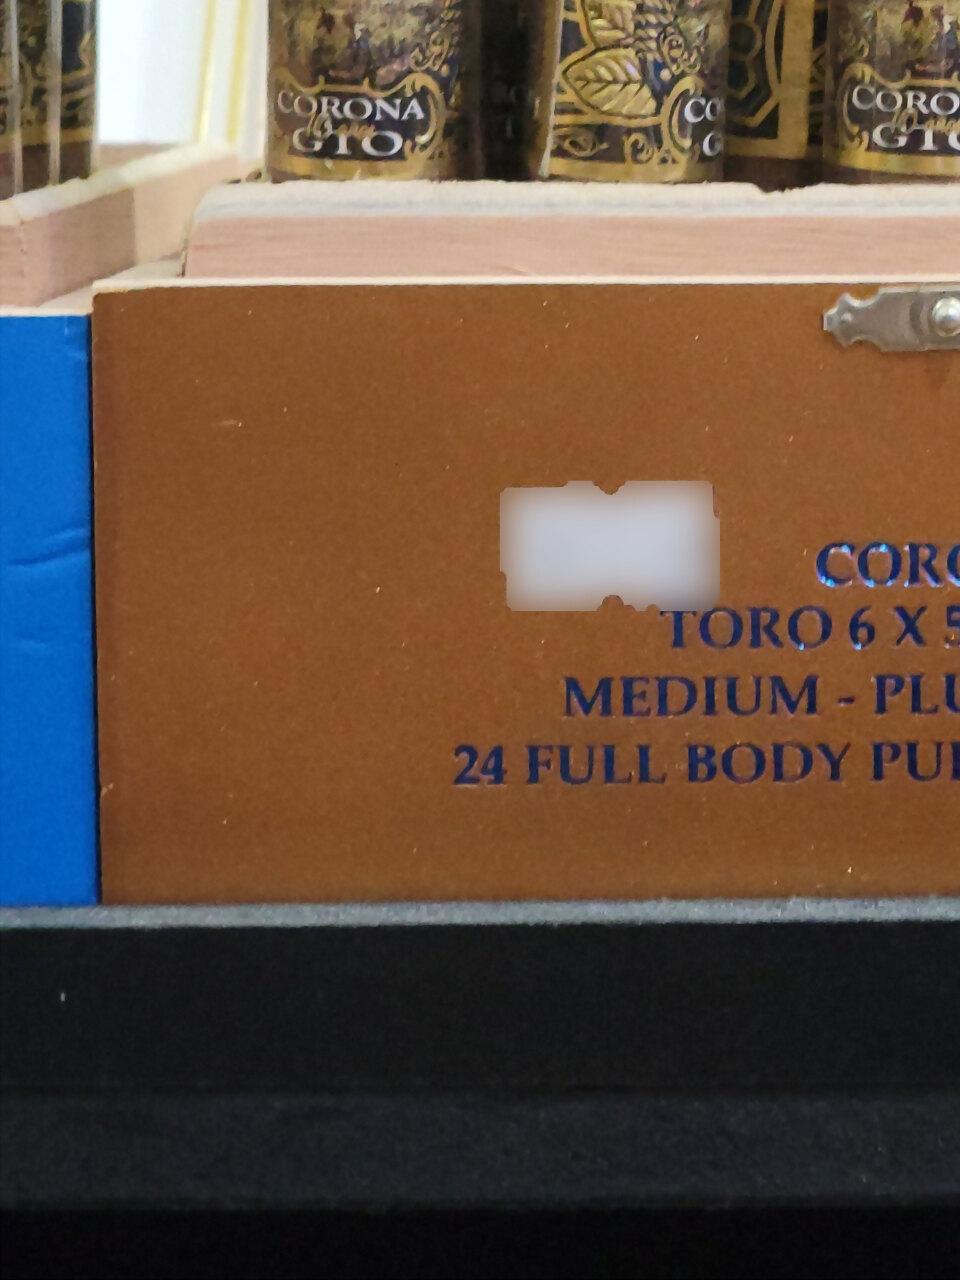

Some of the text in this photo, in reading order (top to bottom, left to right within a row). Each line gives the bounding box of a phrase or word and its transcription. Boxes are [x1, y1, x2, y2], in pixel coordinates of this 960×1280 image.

[277, 88, 425, 121] CORONA
[292, 126, 404, 158] GTO
[659, 607, 834, 650] TORO
[848, 605, 876, 651] 6
[894, 605, 928, 648] X
[563, 674, 821, 719] MEDIUM
[452, 743, 509, 788] 24
[524, 742, 668, 787] FULL
[684, 740, 853, 785] BODY
